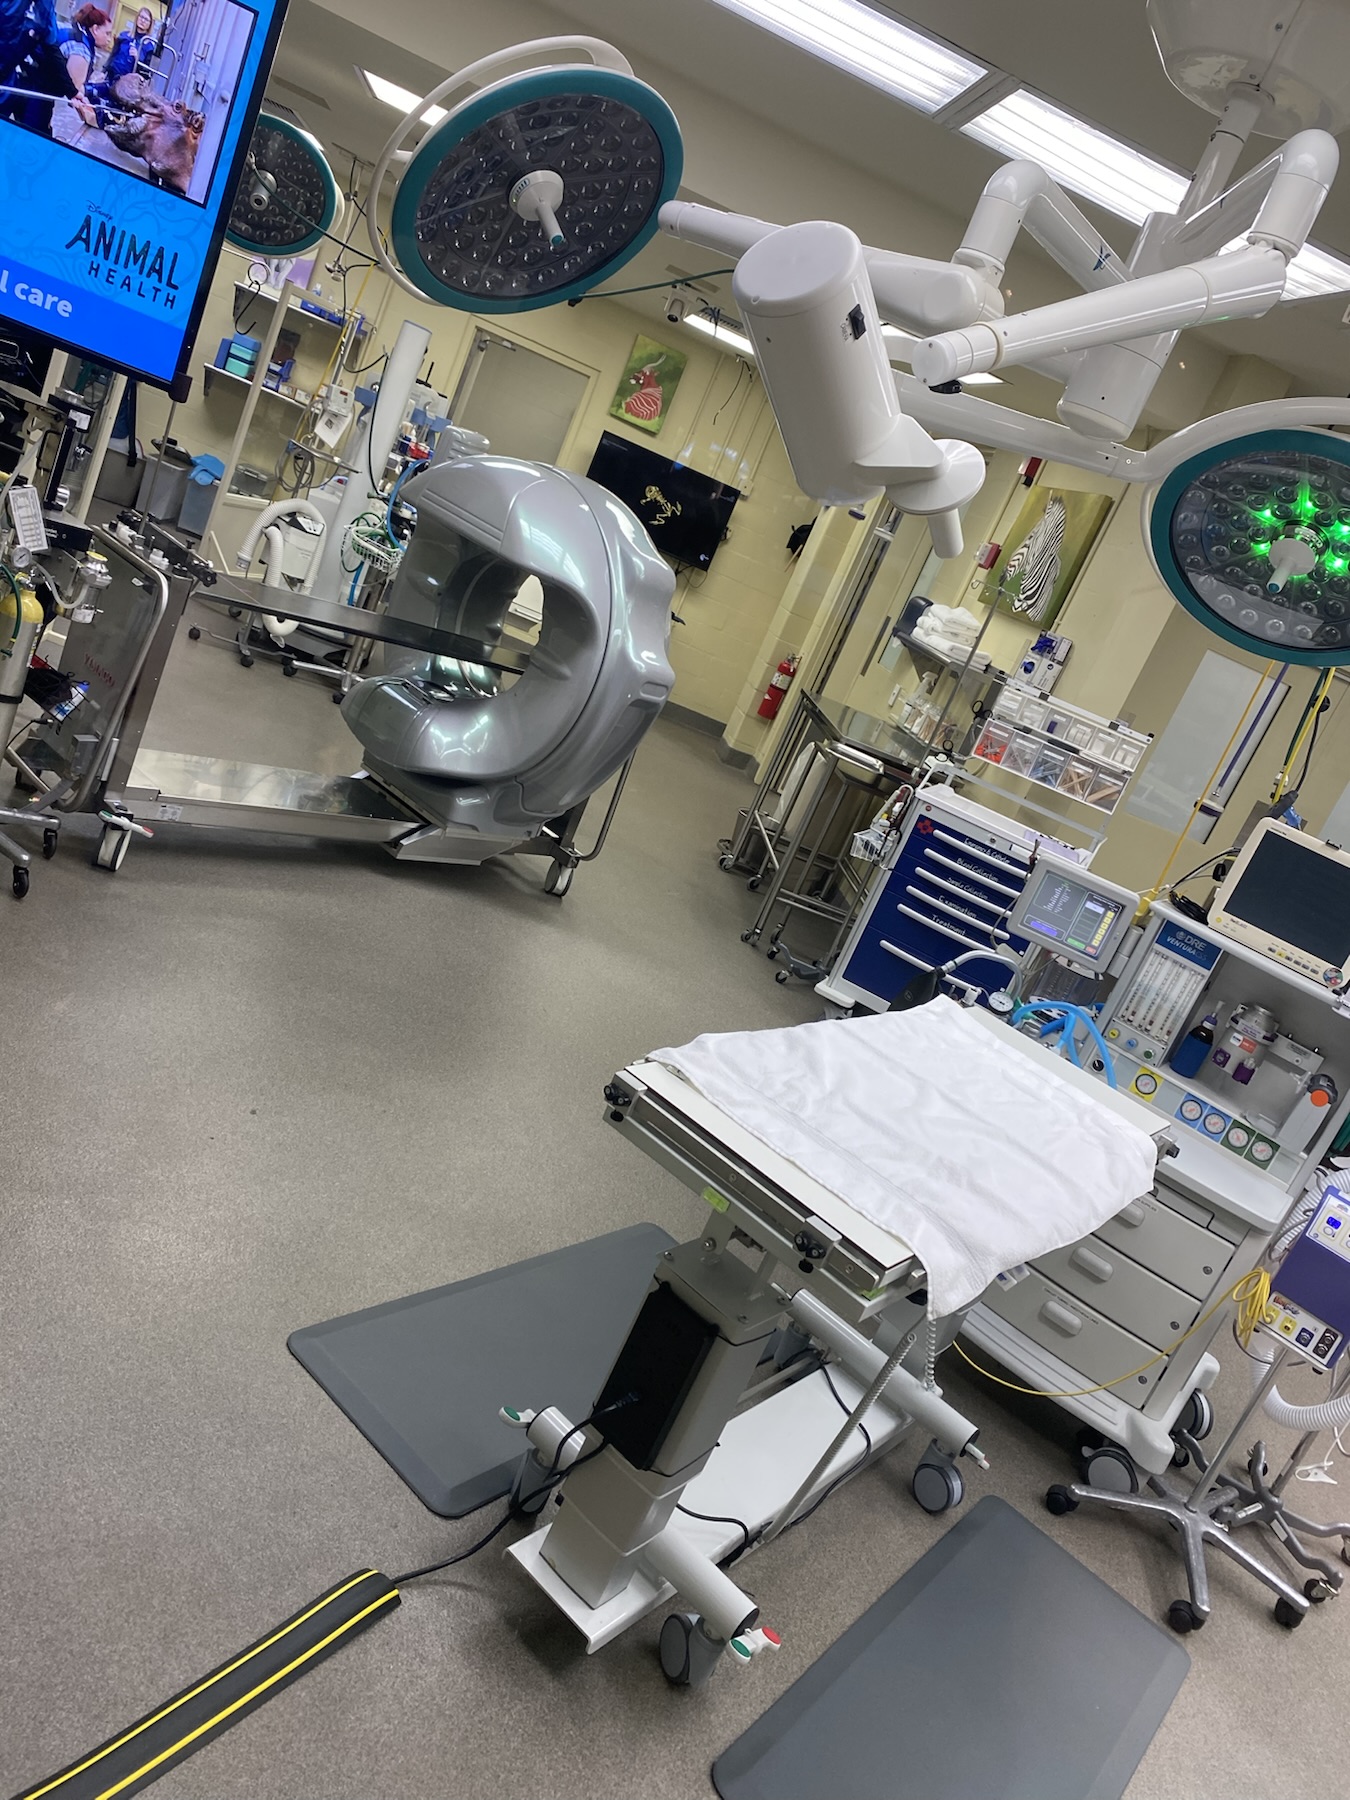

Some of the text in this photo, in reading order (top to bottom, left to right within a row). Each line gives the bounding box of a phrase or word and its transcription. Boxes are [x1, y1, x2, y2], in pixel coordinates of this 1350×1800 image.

[86, 200, 113, 221] Disney
[65, 214, 179, 290] ANIMAL
[88, 260, 176, 309] HEALTH
[14, 283, 73, 318] care
[931, 914, 967, 936] Treatment
[1184, 935, 1207, 951] DRE
